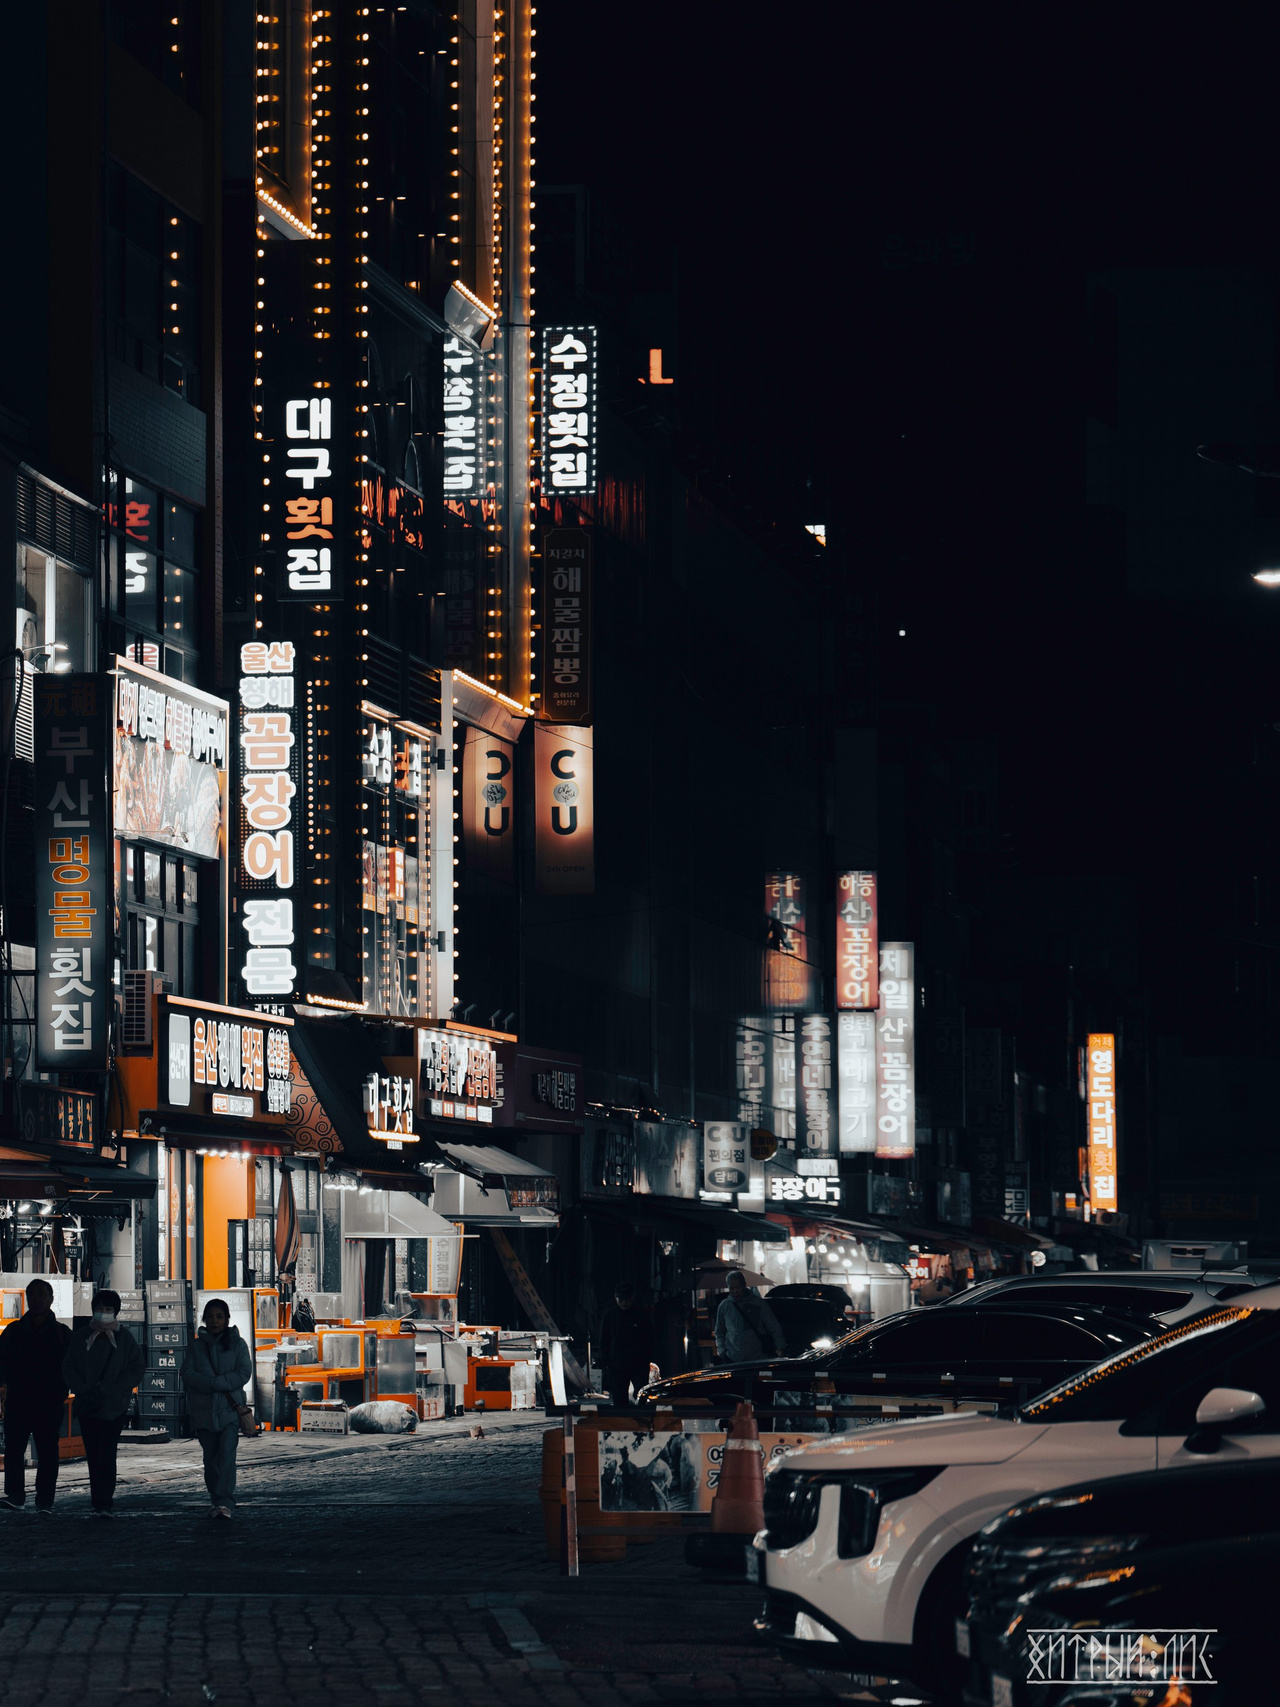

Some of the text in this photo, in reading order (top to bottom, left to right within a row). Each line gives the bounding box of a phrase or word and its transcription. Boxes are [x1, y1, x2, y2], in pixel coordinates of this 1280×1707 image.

[549, 334, 589, 487] 수정횟집
[285, 397, 334, 590] 대구횟집
[551, 566, 583, 685] 해물짬뽕
[241, 641, 296, 674] 울산
[40, 681, 98, 717] 元祖
[239, 676, 294, 708] 청해
[241, 713, 297, 889] 꼼장어
[562, 865, 585, 873] OPEN
[839, 875, 875, 897] 하동
[241, 899, 297, 995] 전문
[878, 950, 909, 1010] 제일
[367, 1072, 414, 1134] 대구횟집
[842, 1032, 871, 1139] 고래고기
[709, 1149, 745, 1163] 편의점
[714, 1170, 738, 1184] 담배
